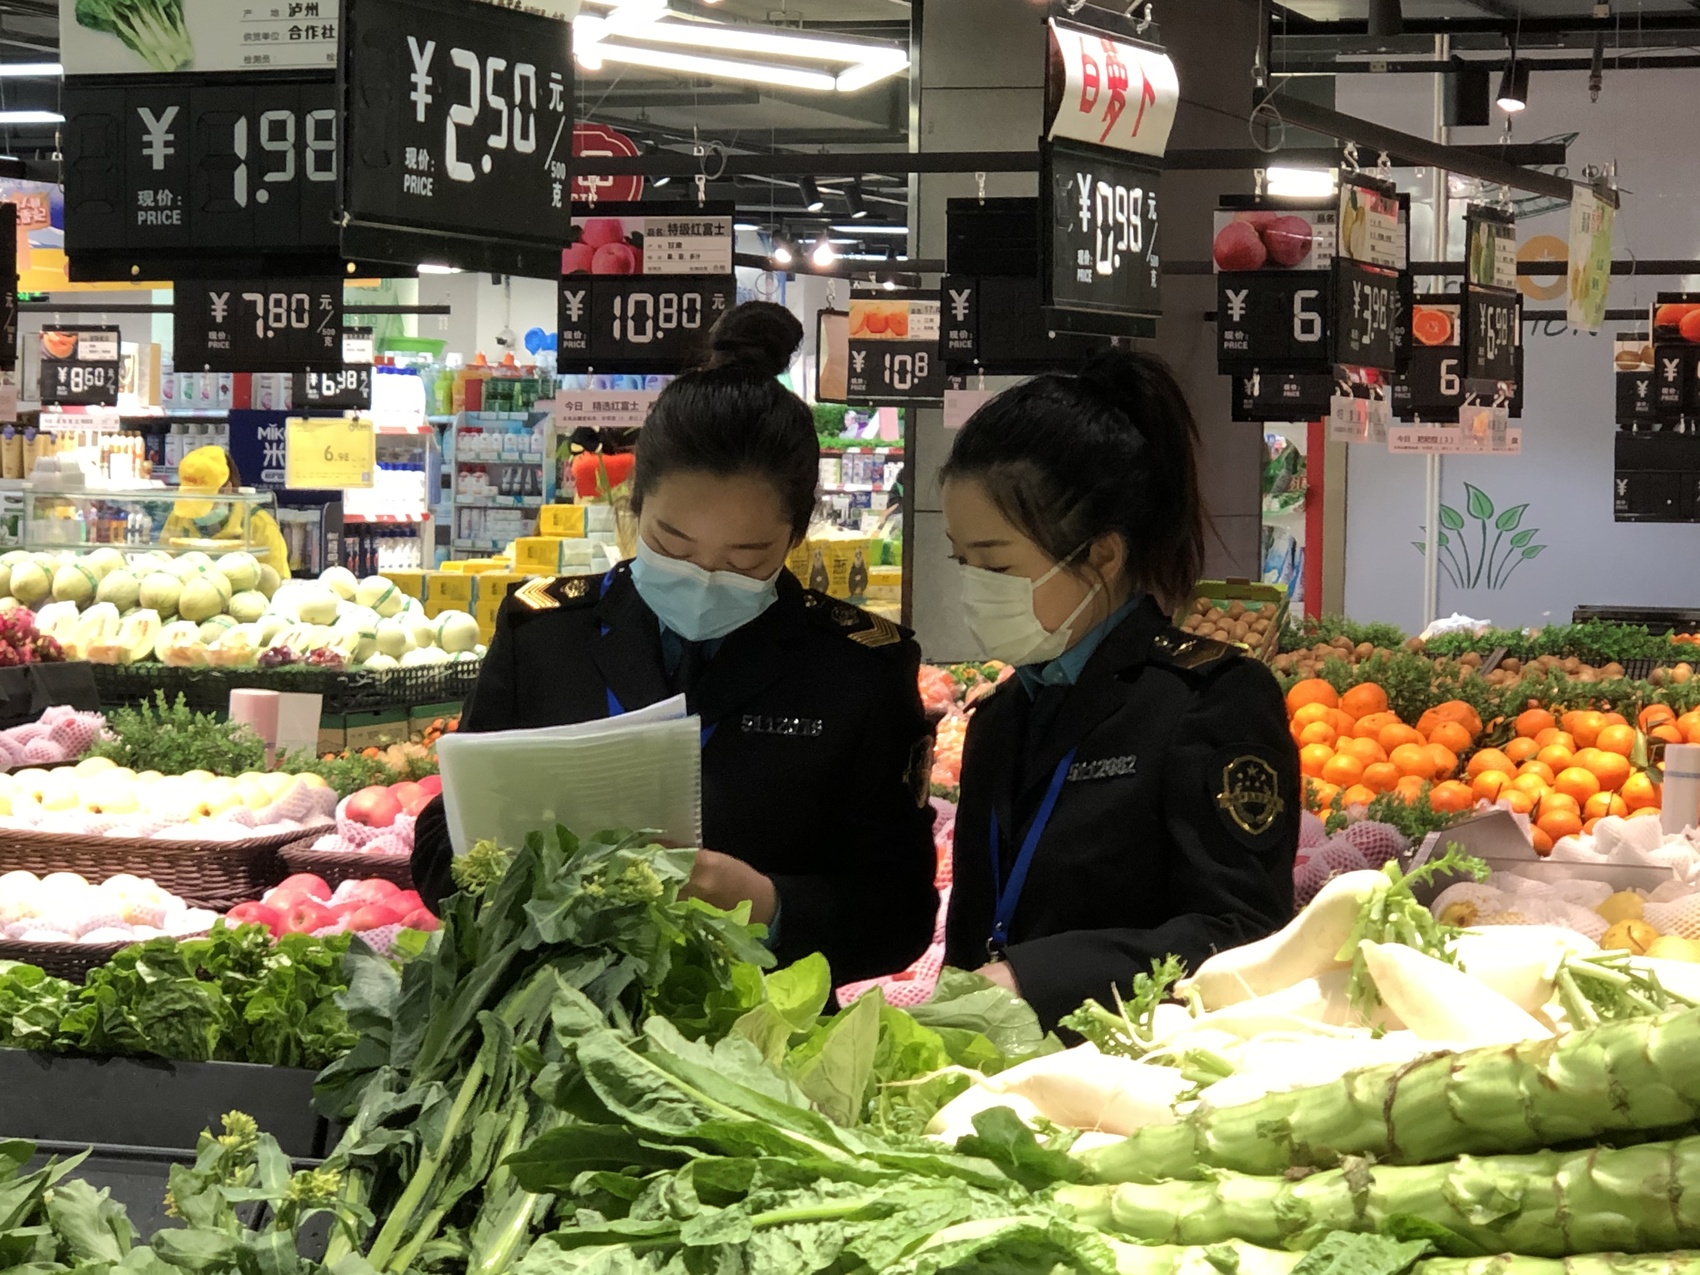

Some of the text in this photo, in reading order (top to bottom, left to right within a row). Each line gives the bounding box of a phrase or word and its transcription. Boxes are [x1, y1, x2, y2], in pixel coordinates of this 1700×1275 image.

[288, 2, 319, 18] 泸州
[288, 24, 336, 41] 合作社
[549, 72, 564, 112] 元
[446, 47, 537, 182] 2.50
[233, 108, 338, 209] 1.98
[404, 146, 435, 172] 现价:
[551, 160, 566, 181] 500
[403, 173, 434, 197] PRICE
[551, 181, 563, 208] 克
[136, 188, 182, 207] 现价:
[137, 209, 182, 226] PRICE
[667, 222, 726, 236] 特级红富士
[1096, 181, 1143, 276] 0.98
[319, 294, 332, 310] 元
[711, 293, 726, 310] 元
[241, 292, 310, 339] 7.80
[613, 293, 701, 343] 10.80
[1293, 289, 1322, 342] 6
[1361, 284, 1388, 345] 3.98
[321, 327, 336, 336] 500
[207, 341, 231, 349] PRICE
[563, 340, 586, 349] PRICE
[948, 340, 973, 349] PRICE
[1223, 341, 1249, 350] PRICE
[70, 367, 105, 393] 8.60
[884, 351, 928, 390] 10.8
[1440, 359, 1460, 395] 6
[565, 401, 639, 412] 今日 精选红富士
[324, 445, 350, 462] 6.98
